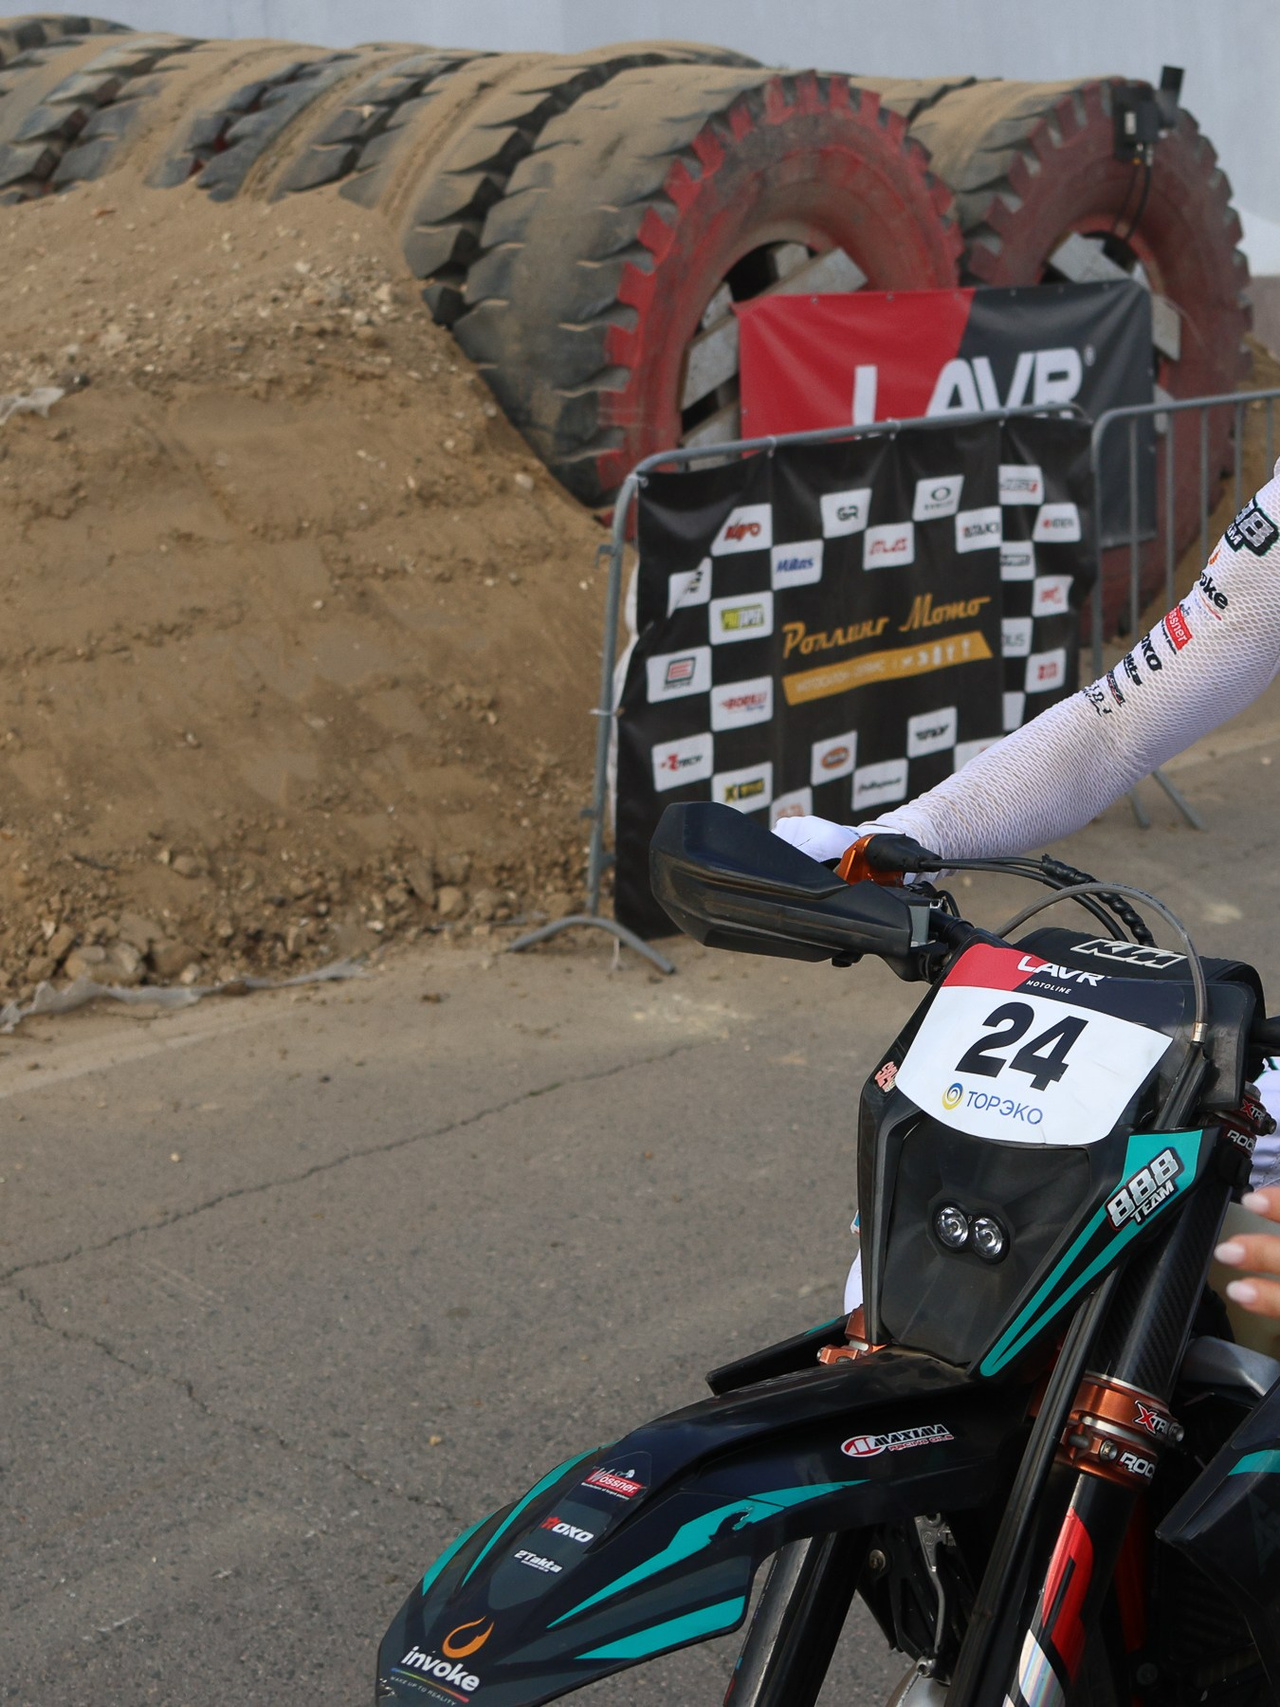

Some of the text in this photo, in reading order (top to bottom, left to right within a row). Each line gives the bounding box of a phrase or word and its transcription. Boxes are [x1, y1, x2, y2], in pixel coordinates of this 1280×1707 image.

[1017, 955, 1106, 987] LAVR
[1070, 939, 1188, 969] KTM
[1026, 980, 1072, 995] MOTOLINE
[954, 1001, 1089, 1092] 24
[966, 1090, 1044, 1126] ТОРЭКО
[1107, 1149, 1179, 1227] 888
[1130, 1179, 1175, 1223] TEAM
[874, 1424, 950, 1448] MAXIMA
[400, 1645, 480, 1692] invoke
